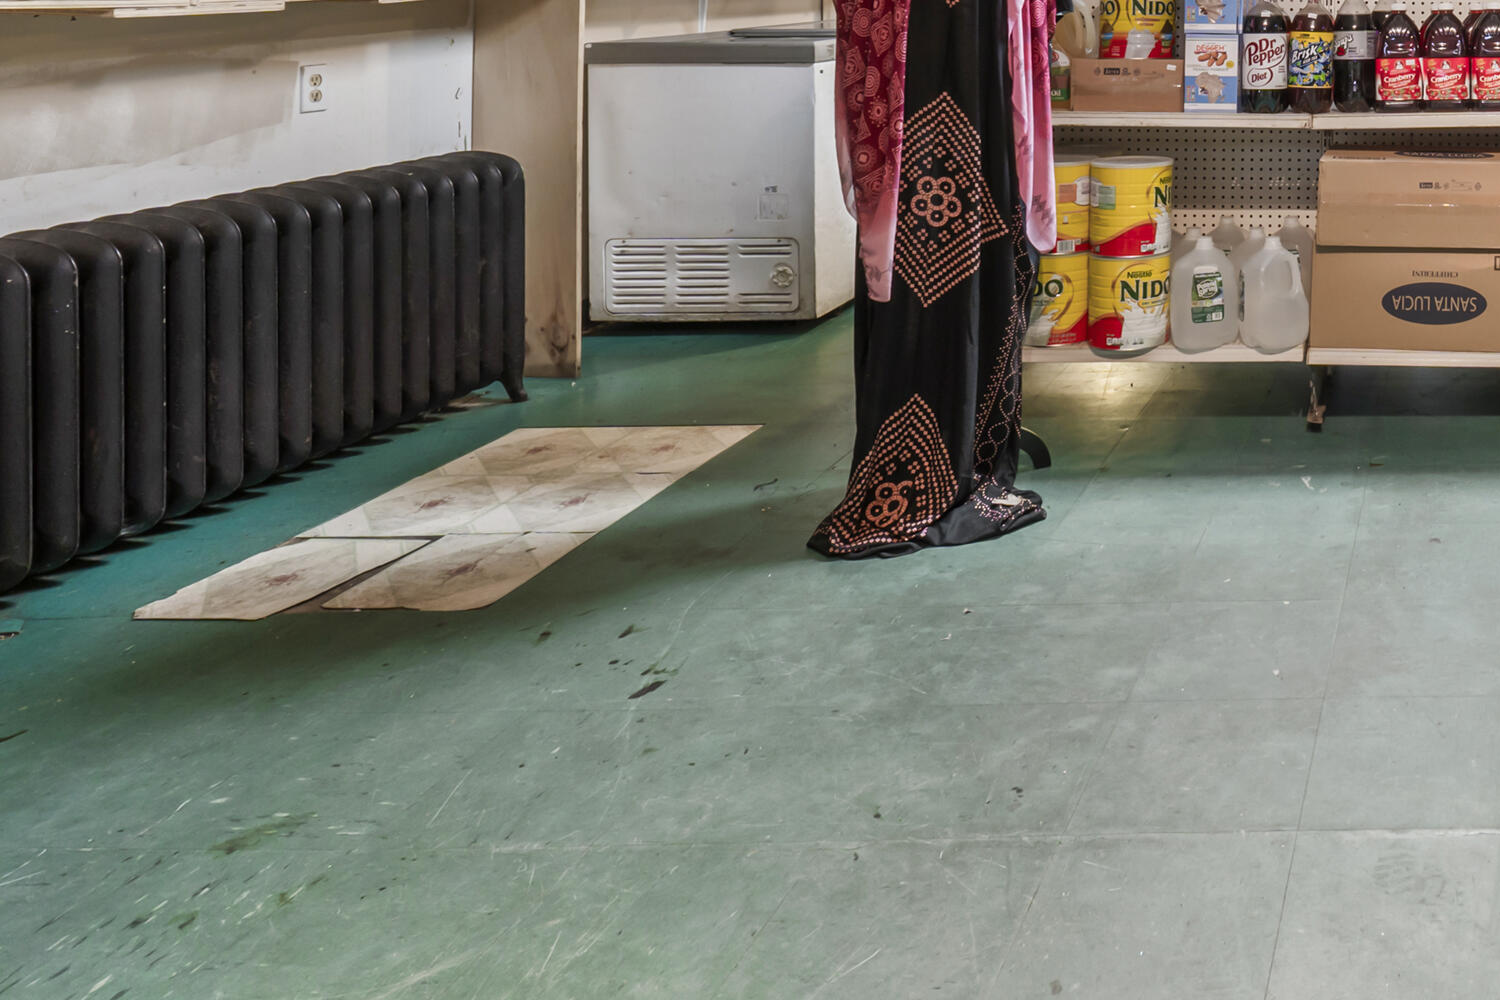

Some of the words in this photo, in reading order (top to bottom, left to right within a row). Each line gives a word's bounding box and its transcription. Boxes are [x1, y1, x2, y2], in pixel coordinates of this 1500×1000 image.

[1259, 38, 1277, 50] Dr
[1247, 40, 1285, 66] Pepper
[1292, 44, 1318, 63] Brisk
[1251, 72, 1268, 83] Diet
[1383, 73, 1416, 83] Cranberry
[1430, 73, 1463, 83] Cranberry
[1392, 295, 1430, 311] LUCIA
[1434, 296, 1478, 312] SANTA
